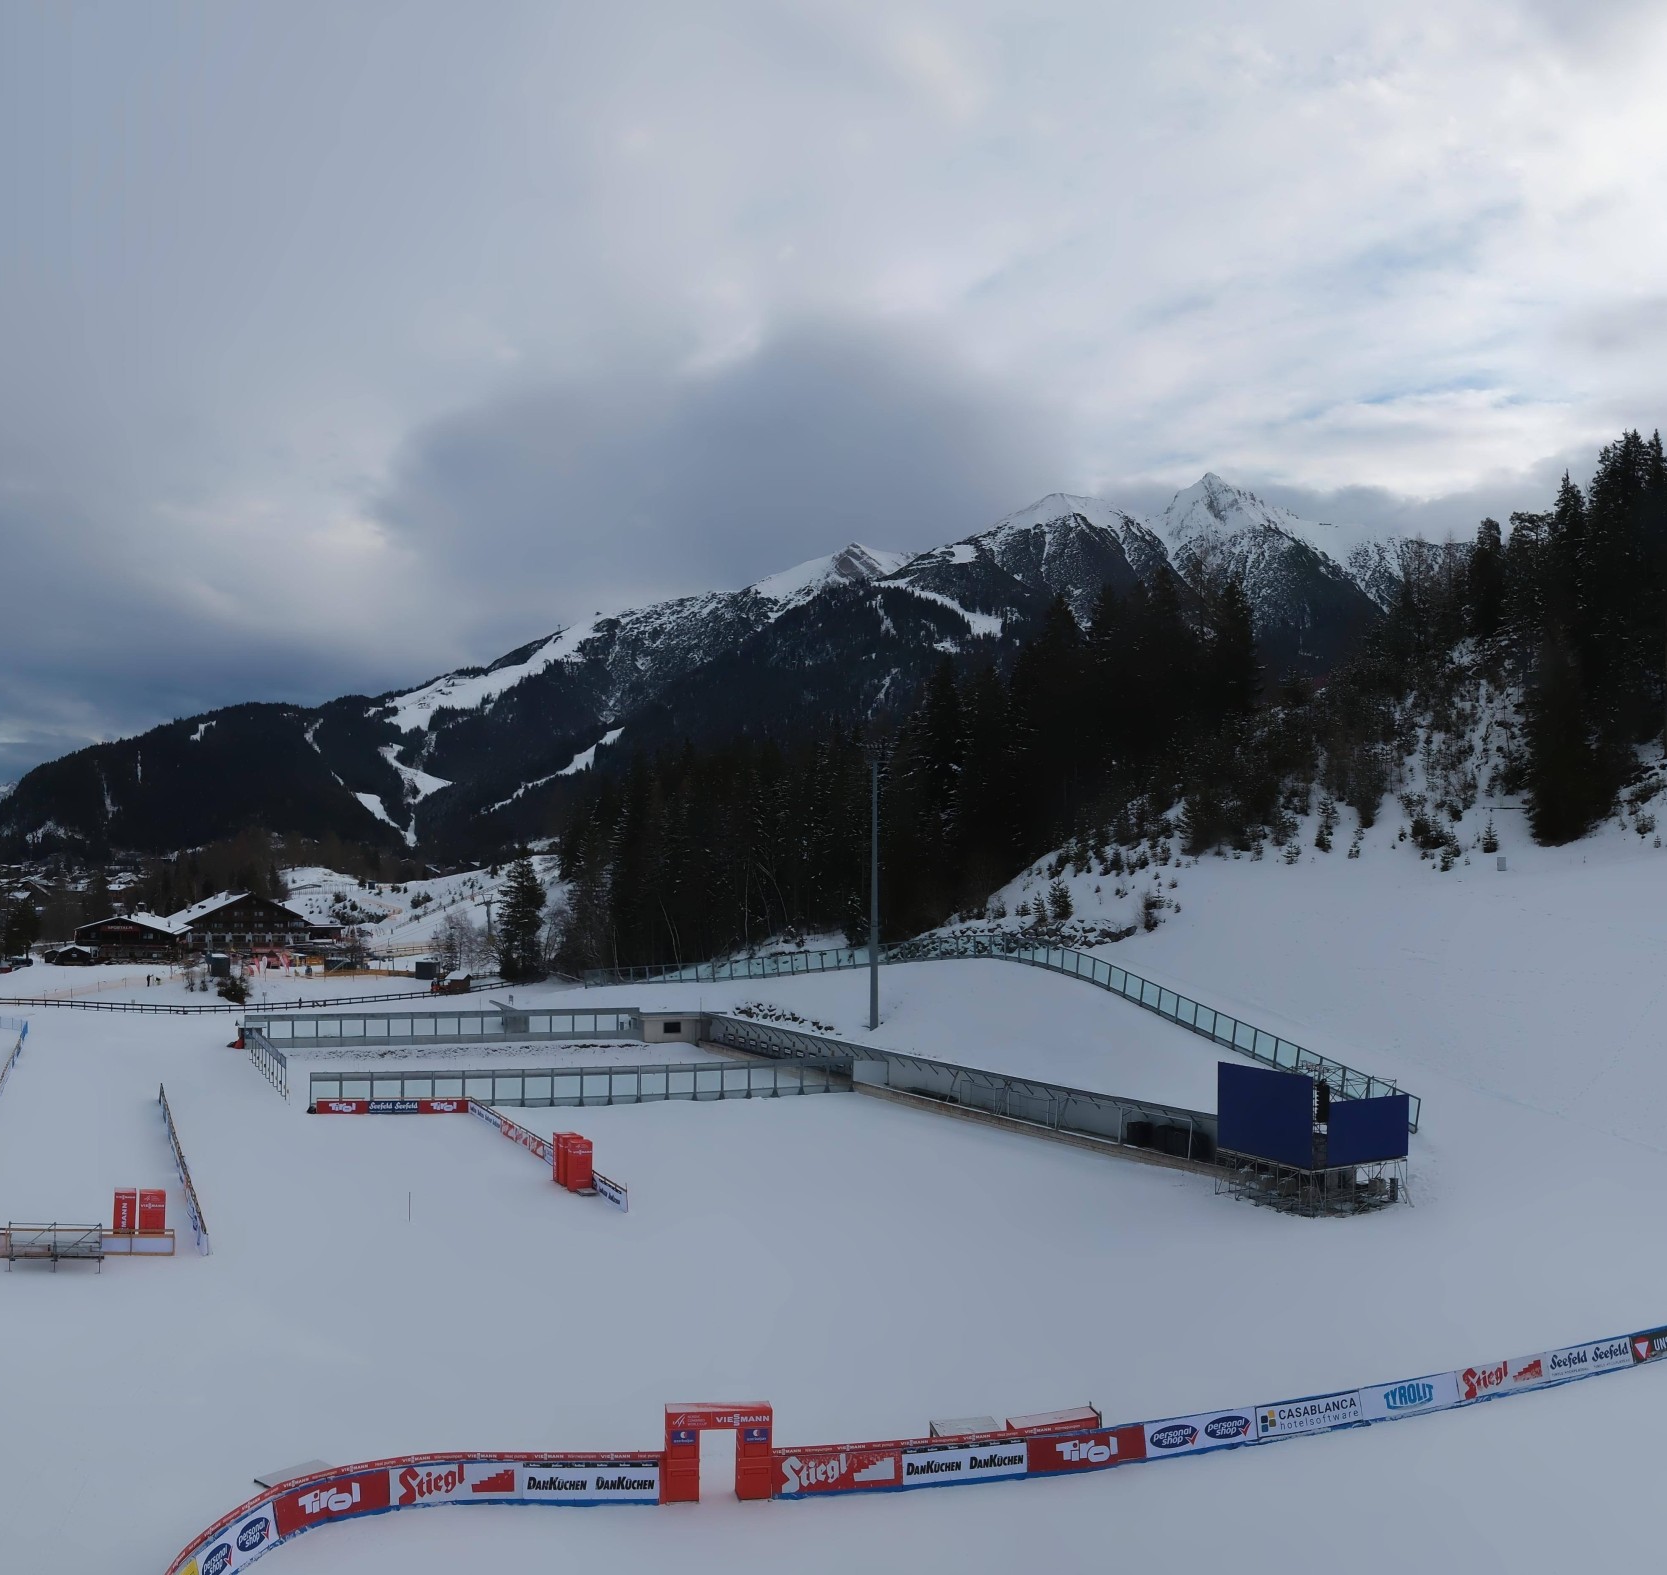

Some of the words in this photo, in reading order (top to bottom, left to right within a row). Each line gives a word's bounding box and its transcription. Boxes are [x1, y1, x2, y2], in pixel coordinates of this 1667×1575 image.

[329, 1102, 356, 1113] Tirol
[431, 1101, 457, 1112] Tirol
[1550, 1350, 1588, 1370] Seefeld
[1592, 1342, 1629, 1362] Seefeld
[1462, 1361, 1508, 1400] Stiegl
[1384, 1383, 1433, 1406] TYROLIT
[715, 1413, 770, 1427] VIESSMANN
[1278, 1397, 1357, 1420] CASABLANCA
[1207, 1419, 1245, 1433] personal
[1215, 1426, 1237, 1437] shop
[1280, 1410, 1359, 1431] hotelsoftware
[1153, 1427, 1192, 1441] personal
[1162, 1434, 1183, 1446] shop
[1056, 1436, 1118, 1463] Tirol
[399, 1463, 465, 1506] Stiegl
[782, 1453, 847, 1493] Stiegl
[298, 1482, 361, 1515] Tirol
[238, 1519, 265, 1546] personal
[245, 1532, 260, 1548] shop
[203, 1544, 228, 1574] personal
